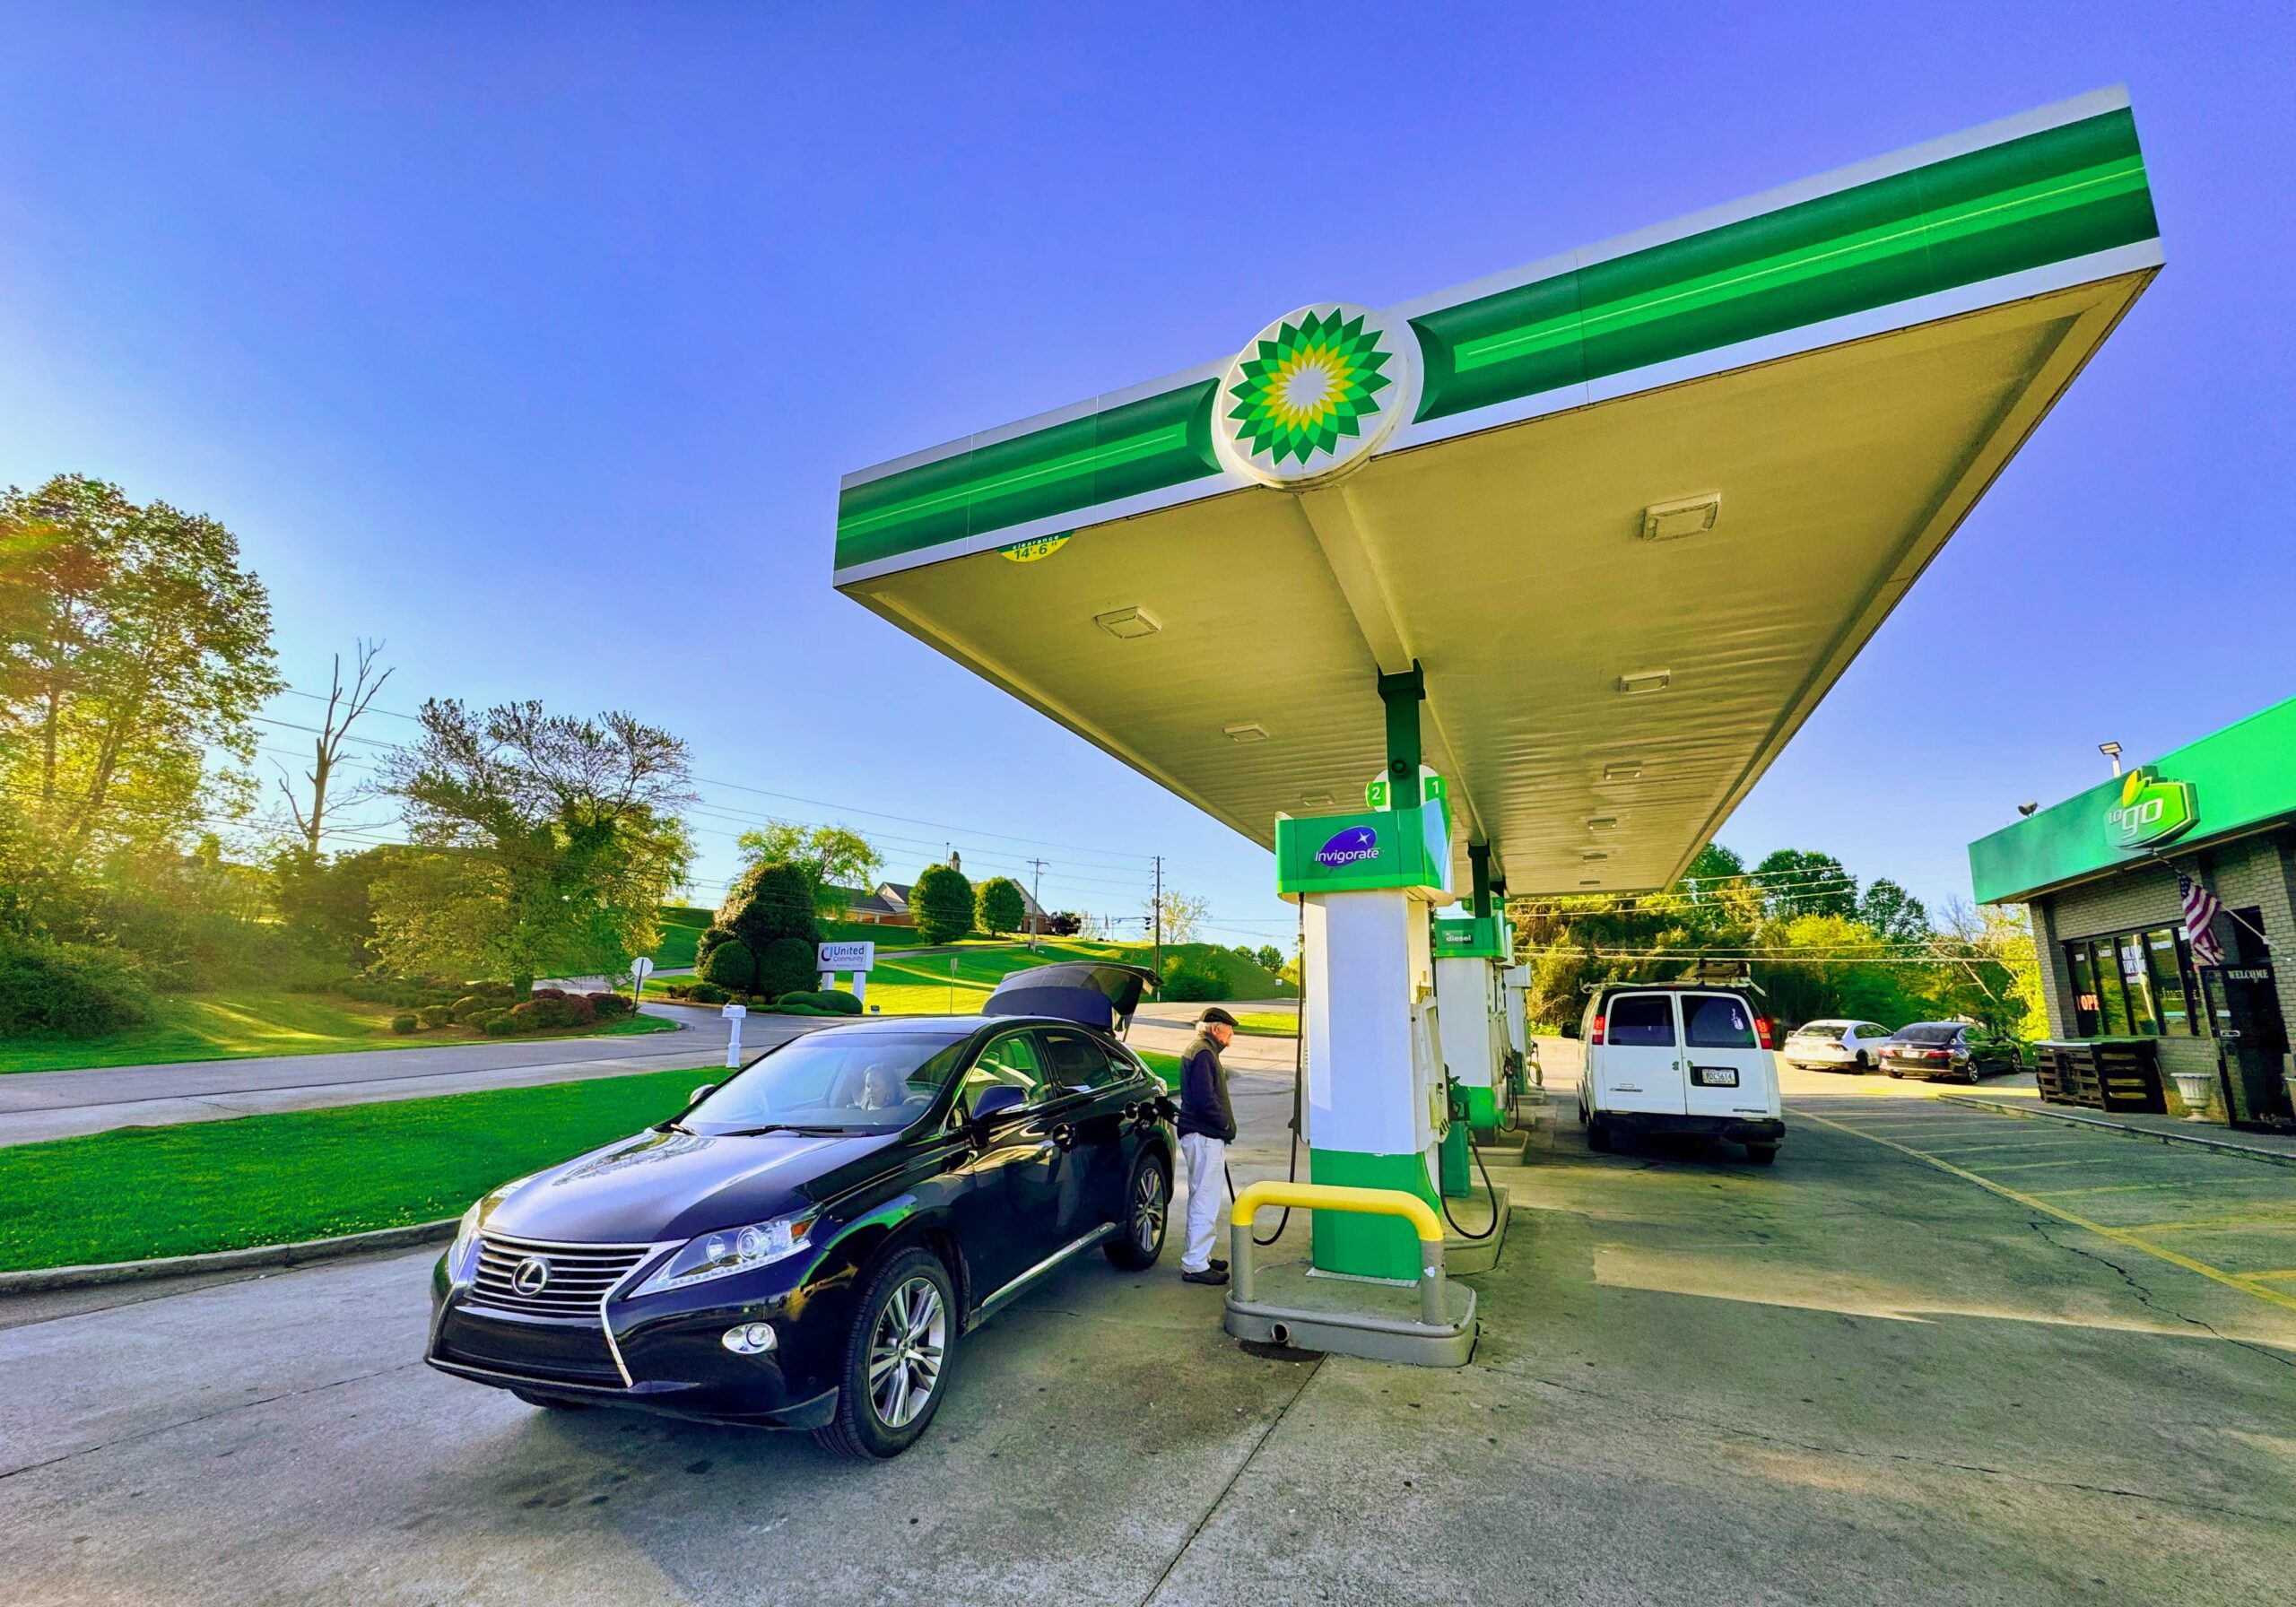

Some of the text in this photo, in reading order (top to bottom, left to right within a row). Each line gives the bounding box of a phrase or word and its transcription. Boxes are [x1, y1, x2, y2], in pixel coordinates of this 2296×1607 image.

[1013, 535, 1059, 550] clearance
[1371, 786, 1381, 800] 2
[1432, 780, 1439, 795] 1
[1446, 934, 1472, 942] diesel
[834, 945, 865, 955] United
[2227, 969, 2269, 979] WELCOME
[2081, 995, 2100, 1011] OPE
